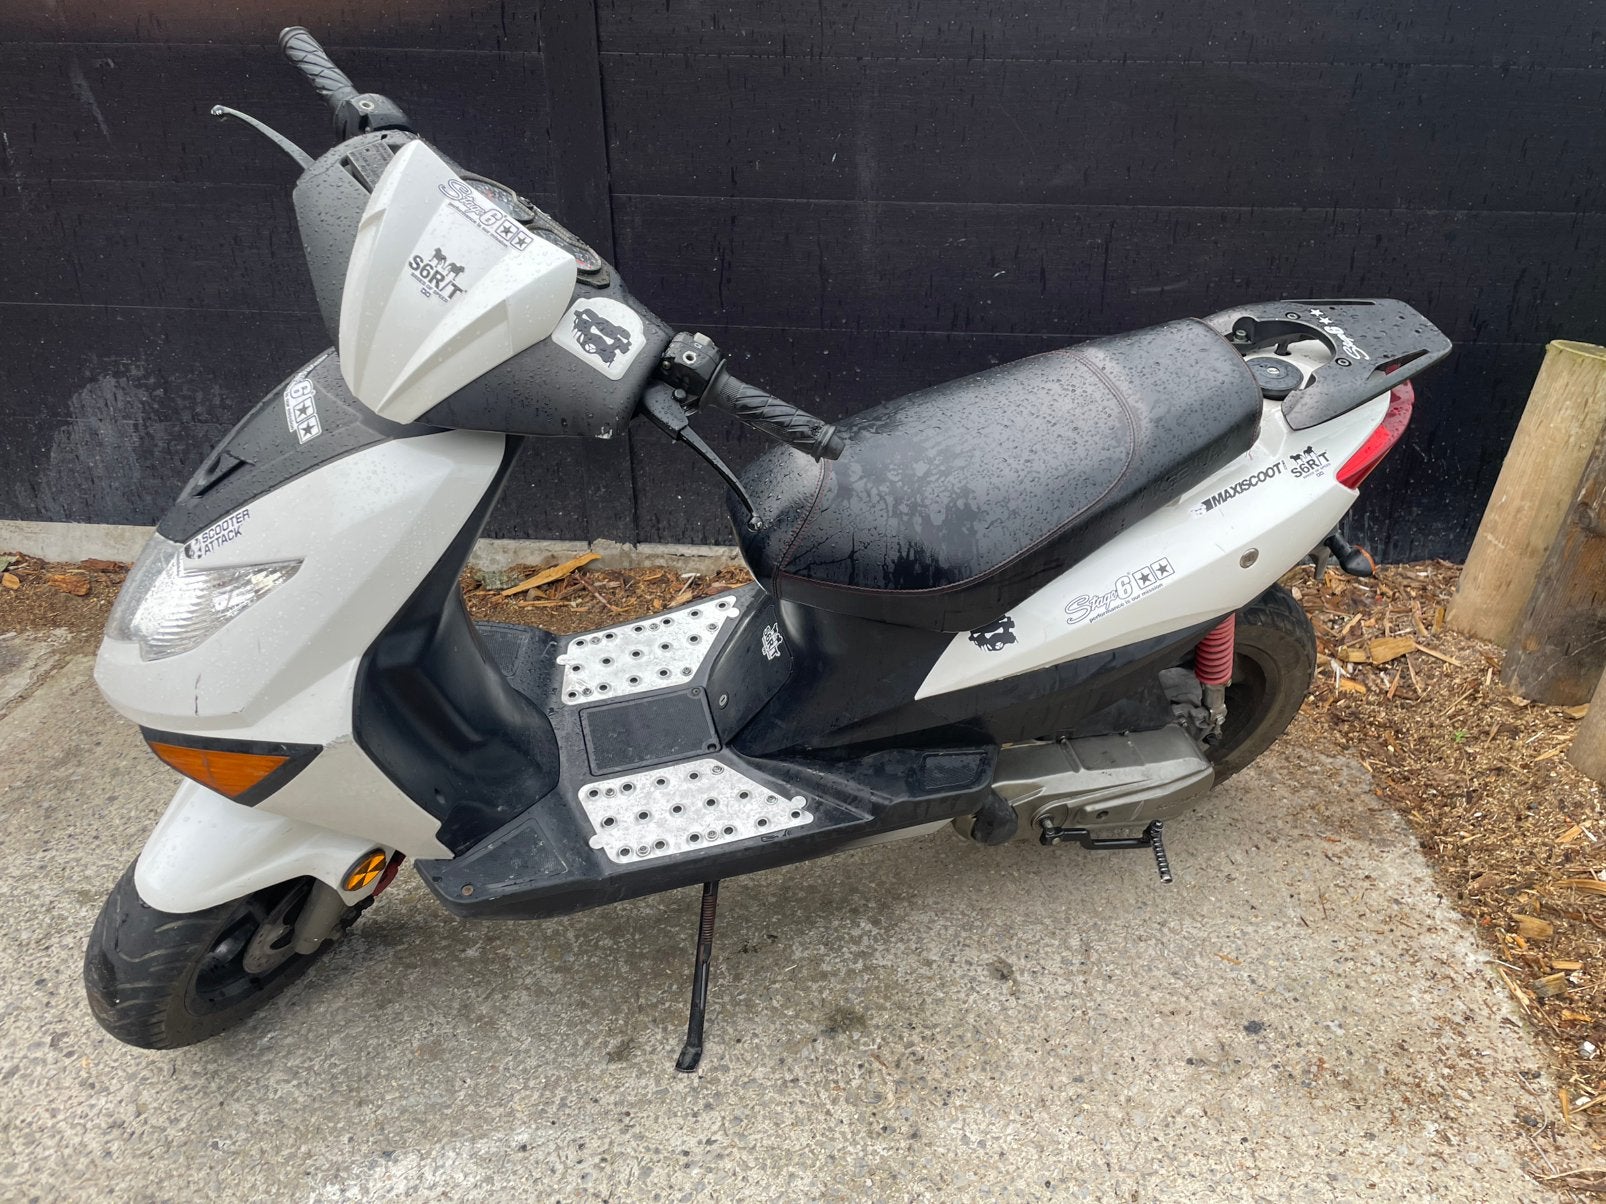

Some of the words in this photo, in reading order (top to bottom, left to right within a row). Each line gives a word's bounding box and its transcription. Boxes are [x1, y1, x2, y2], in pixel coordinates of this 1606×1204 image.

[1211, 461, 1284, 508] MAXISCOOT
[201, 508, 250, 543] SCOOTER
[204, 526, 242, 555] ATTACK
[1089, 602, 1125, 623] performance
[1141, 583, 1164, 597] mission
